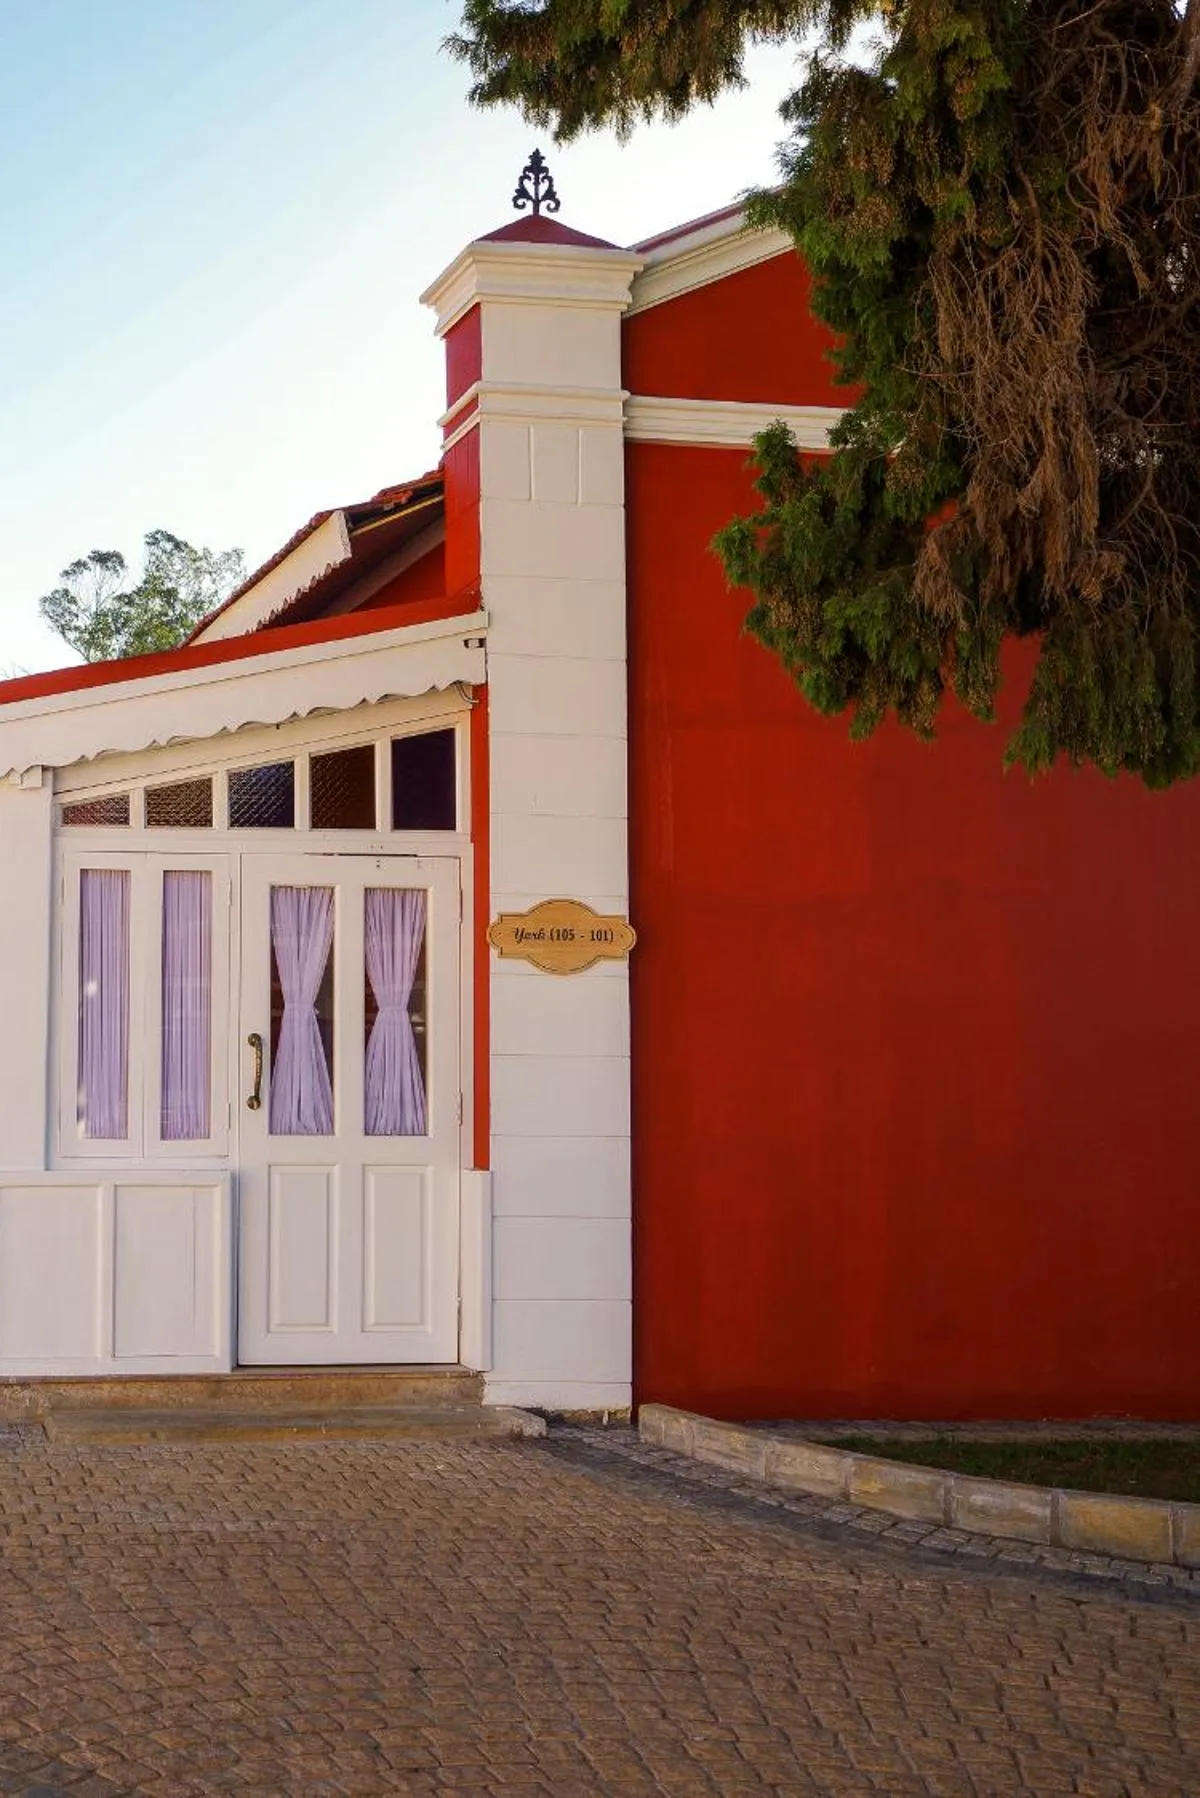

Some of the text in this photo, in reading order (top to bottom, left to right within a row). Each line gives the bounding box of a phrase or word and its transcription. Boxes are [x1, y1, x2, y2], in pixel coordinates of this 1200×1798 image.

[513, 927, 546, 944] York
[550, 928, 575, 942] (105
[590, 929, 614, 943] 101)
